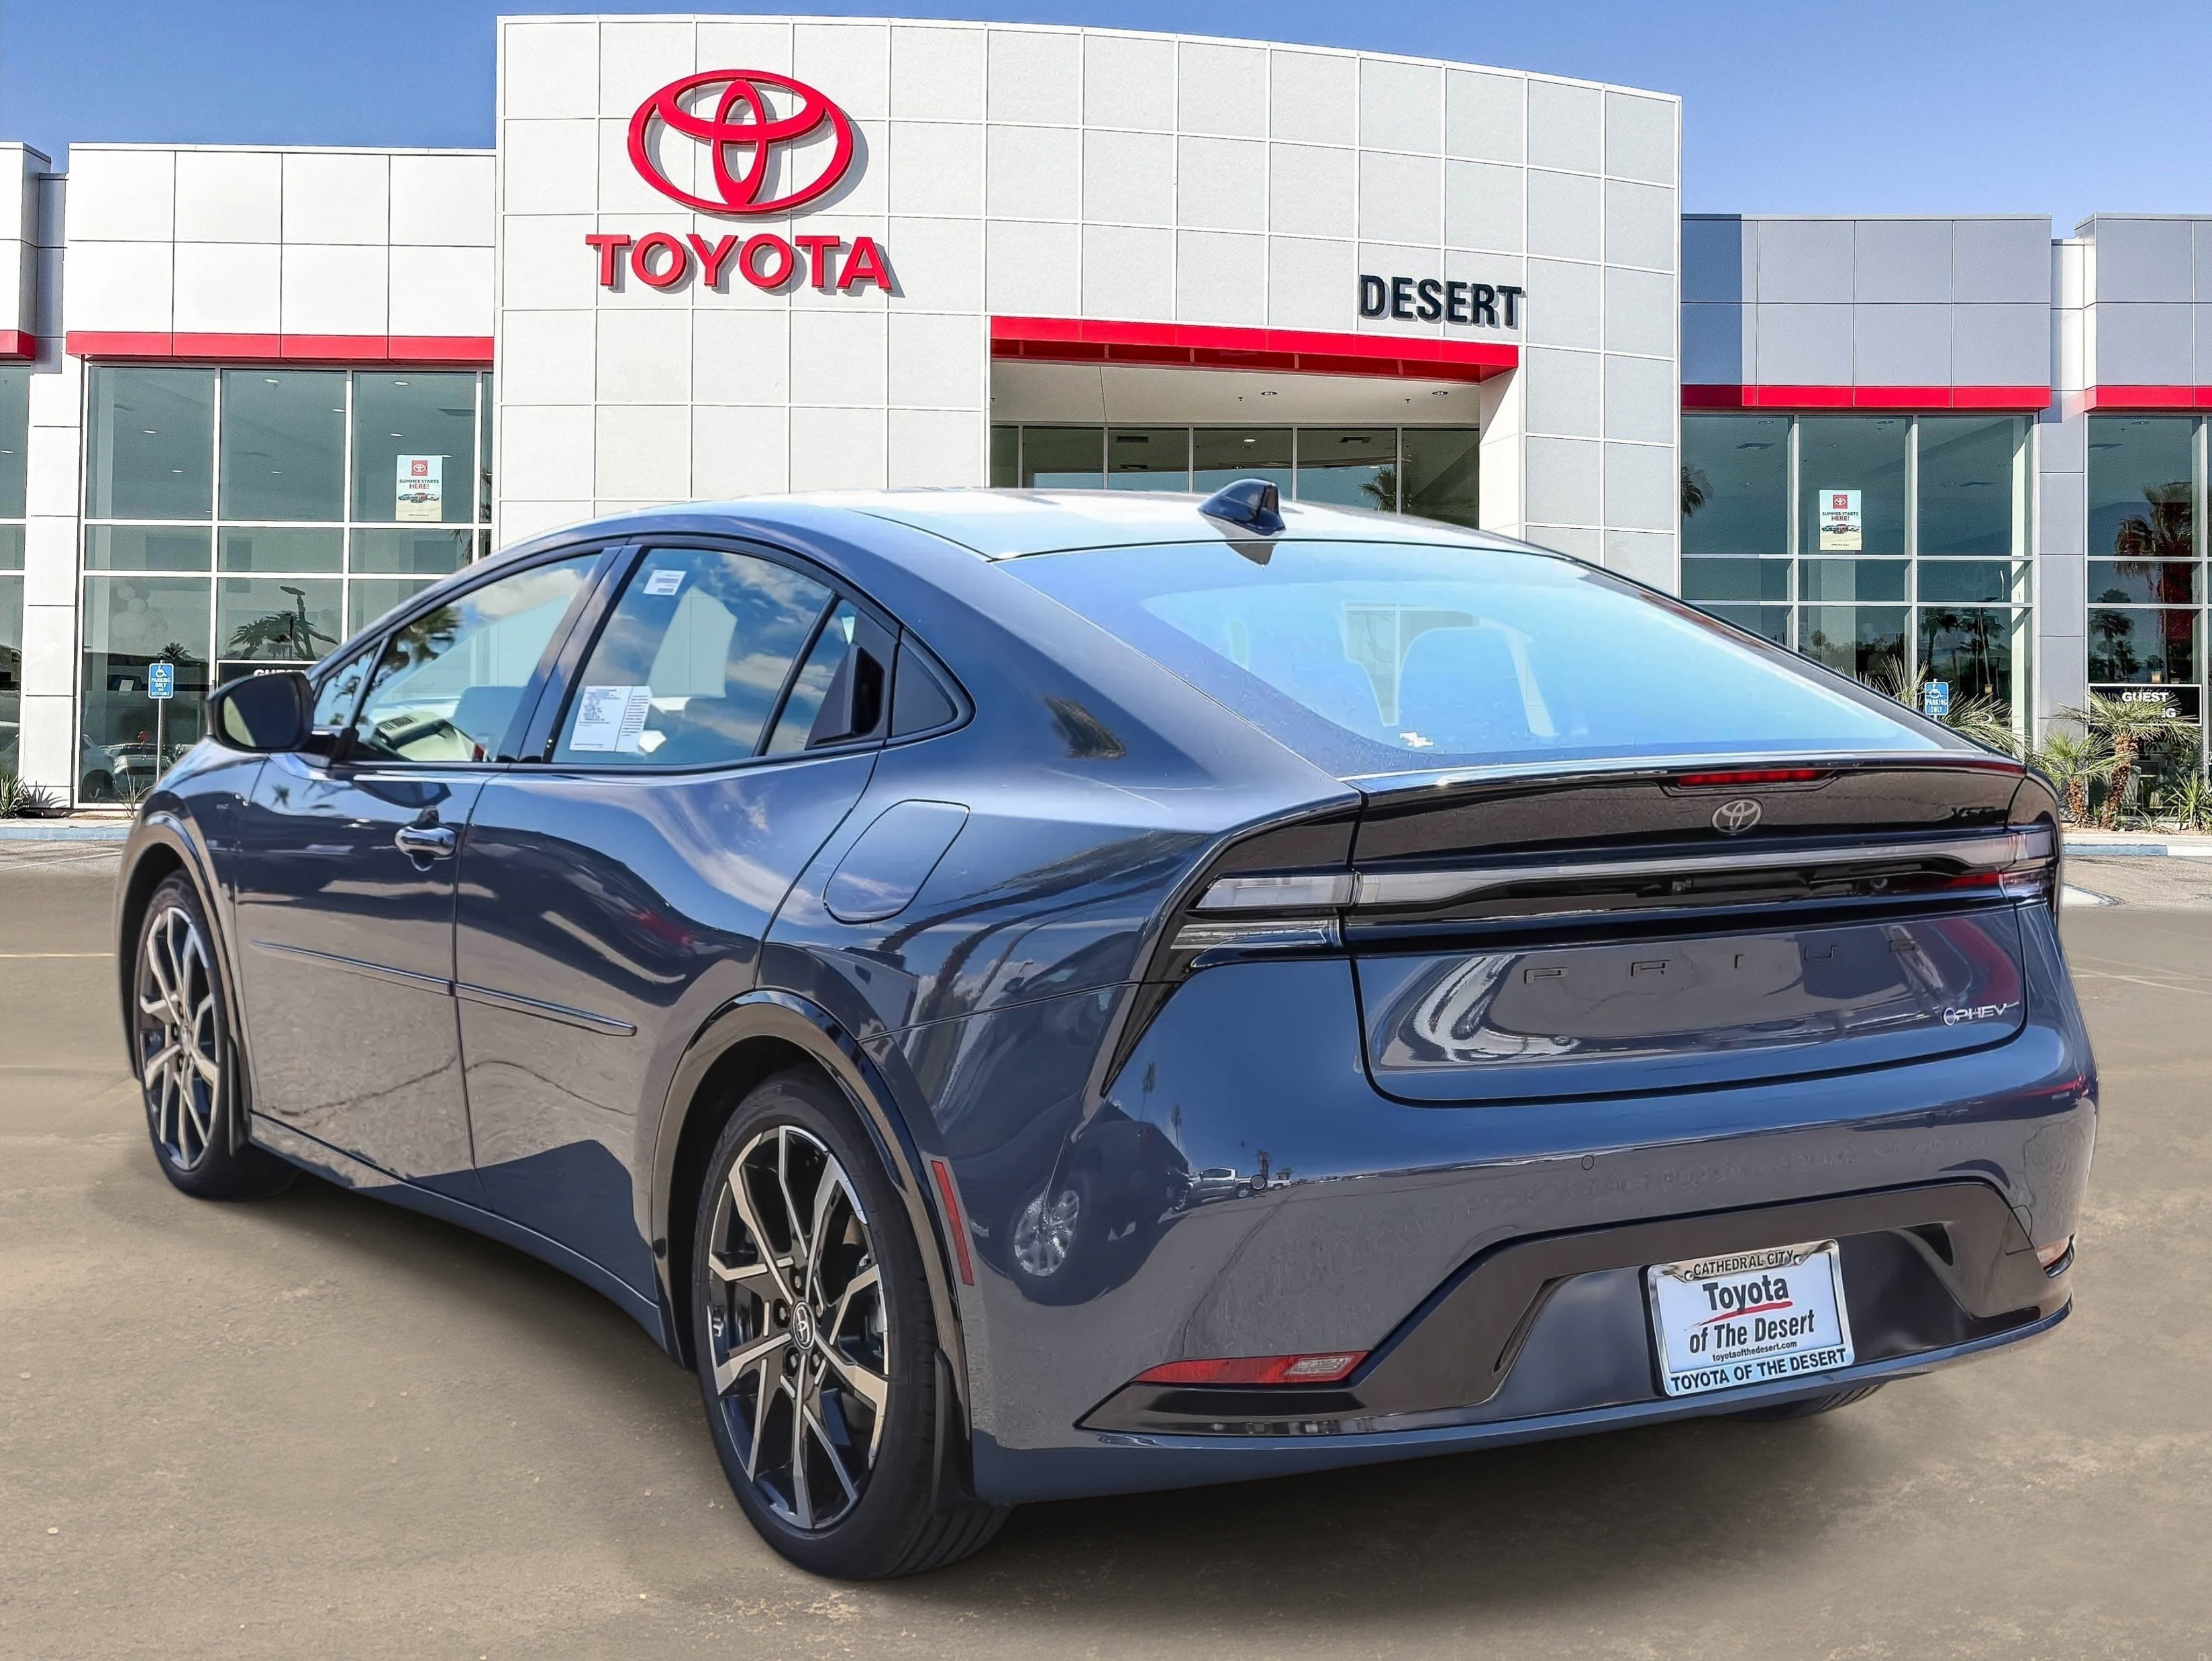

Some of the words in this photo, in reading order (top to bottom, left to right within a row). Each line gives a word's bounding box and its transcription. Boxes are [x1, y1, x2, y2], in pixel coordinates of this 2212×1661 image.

[585, 232, 892, 290] TOYOTA
[1359, 274, 1522, 327] DESERT
[1930, 705, 1943, 713] ONLY
[2122, 691, 2169, 703] GUEST
[1954, 1002, 2019, 1022] PHEV
[1693, 1255, 1764, 1276] CATHEDRAL
[1767, 1249, 1795, 1265] CITY
[1702, 1274, 1790, 1312] Toyota
[1689, 1327, 1708, 1353] of
[1714, 1322, 1748, 1349] The
[1754, 1309, 1815, 1343] Desert
[1712, 1341, 1797, 1362] toyotaofthedesert.com
[1670, 1368, 1730, 1392] TOYOTA
[1733, 1364, 1752, 1380] OF
[1756, 1358, 1787, 1376] THE
[1789, 1348, 1846, 1372] DESERT
